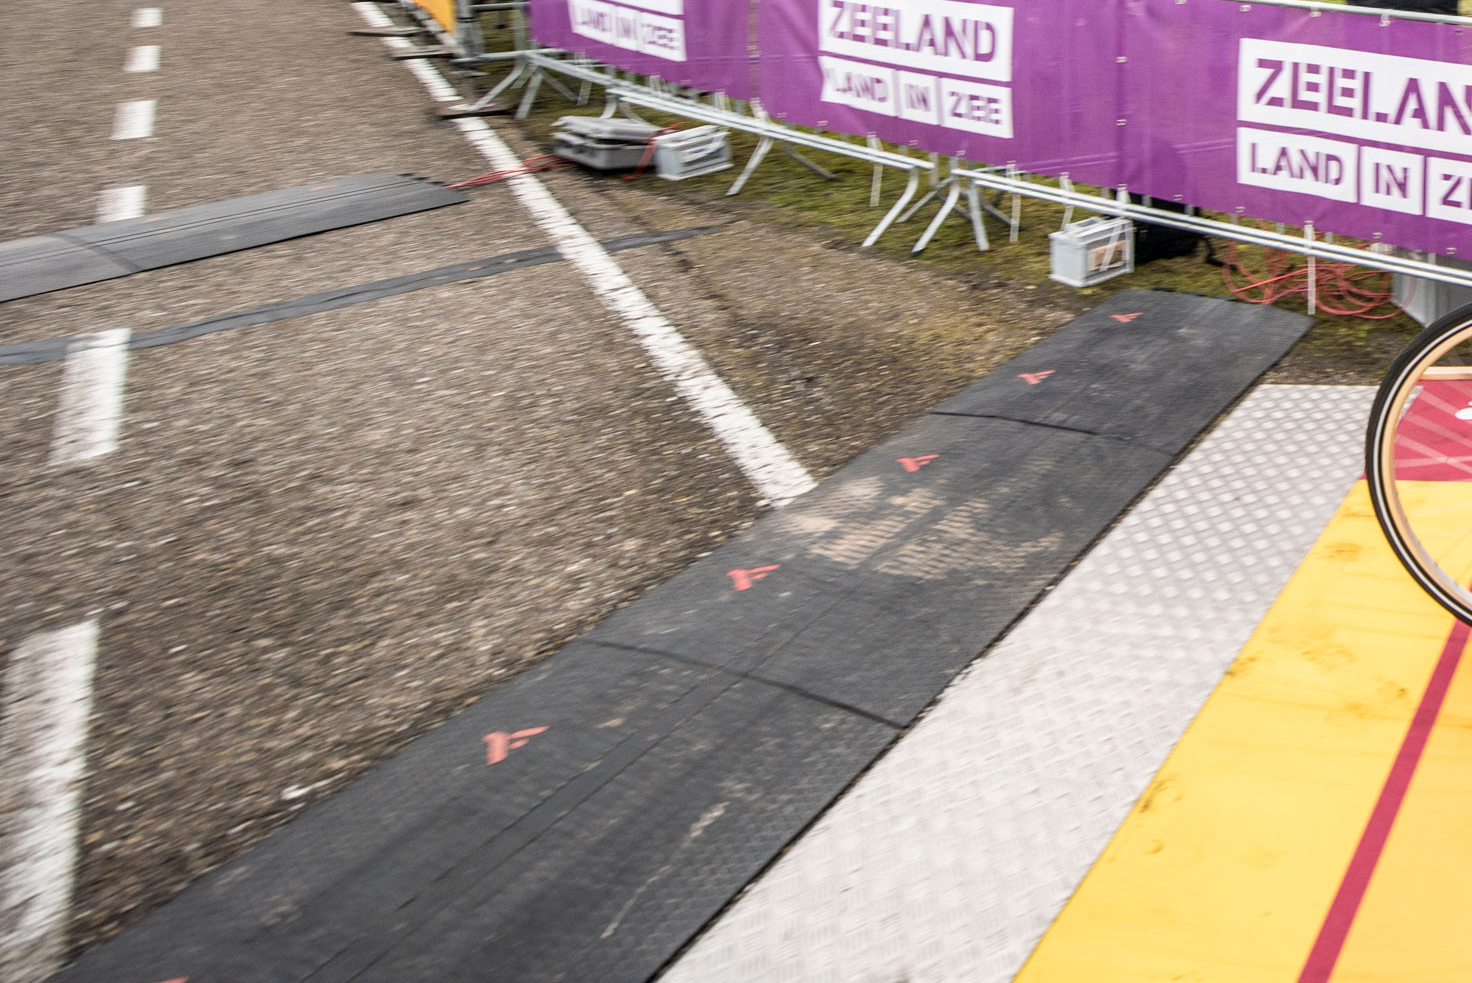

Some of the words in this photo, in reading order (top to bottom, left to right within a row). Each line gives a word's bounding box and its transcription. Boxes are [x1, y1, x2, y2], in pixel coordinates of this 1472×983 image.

[641, 22, 678, 50] ZEE
[830, 0, 997, 63] ZEELAND
[825, 67, 888, 103] LAND
[903, 83, 931, 111] IN
[949, 90, 1001, 125] ZEE
[1251, 142, 1345, 187] LAND
[1374, 161, 1410, 199] IN
